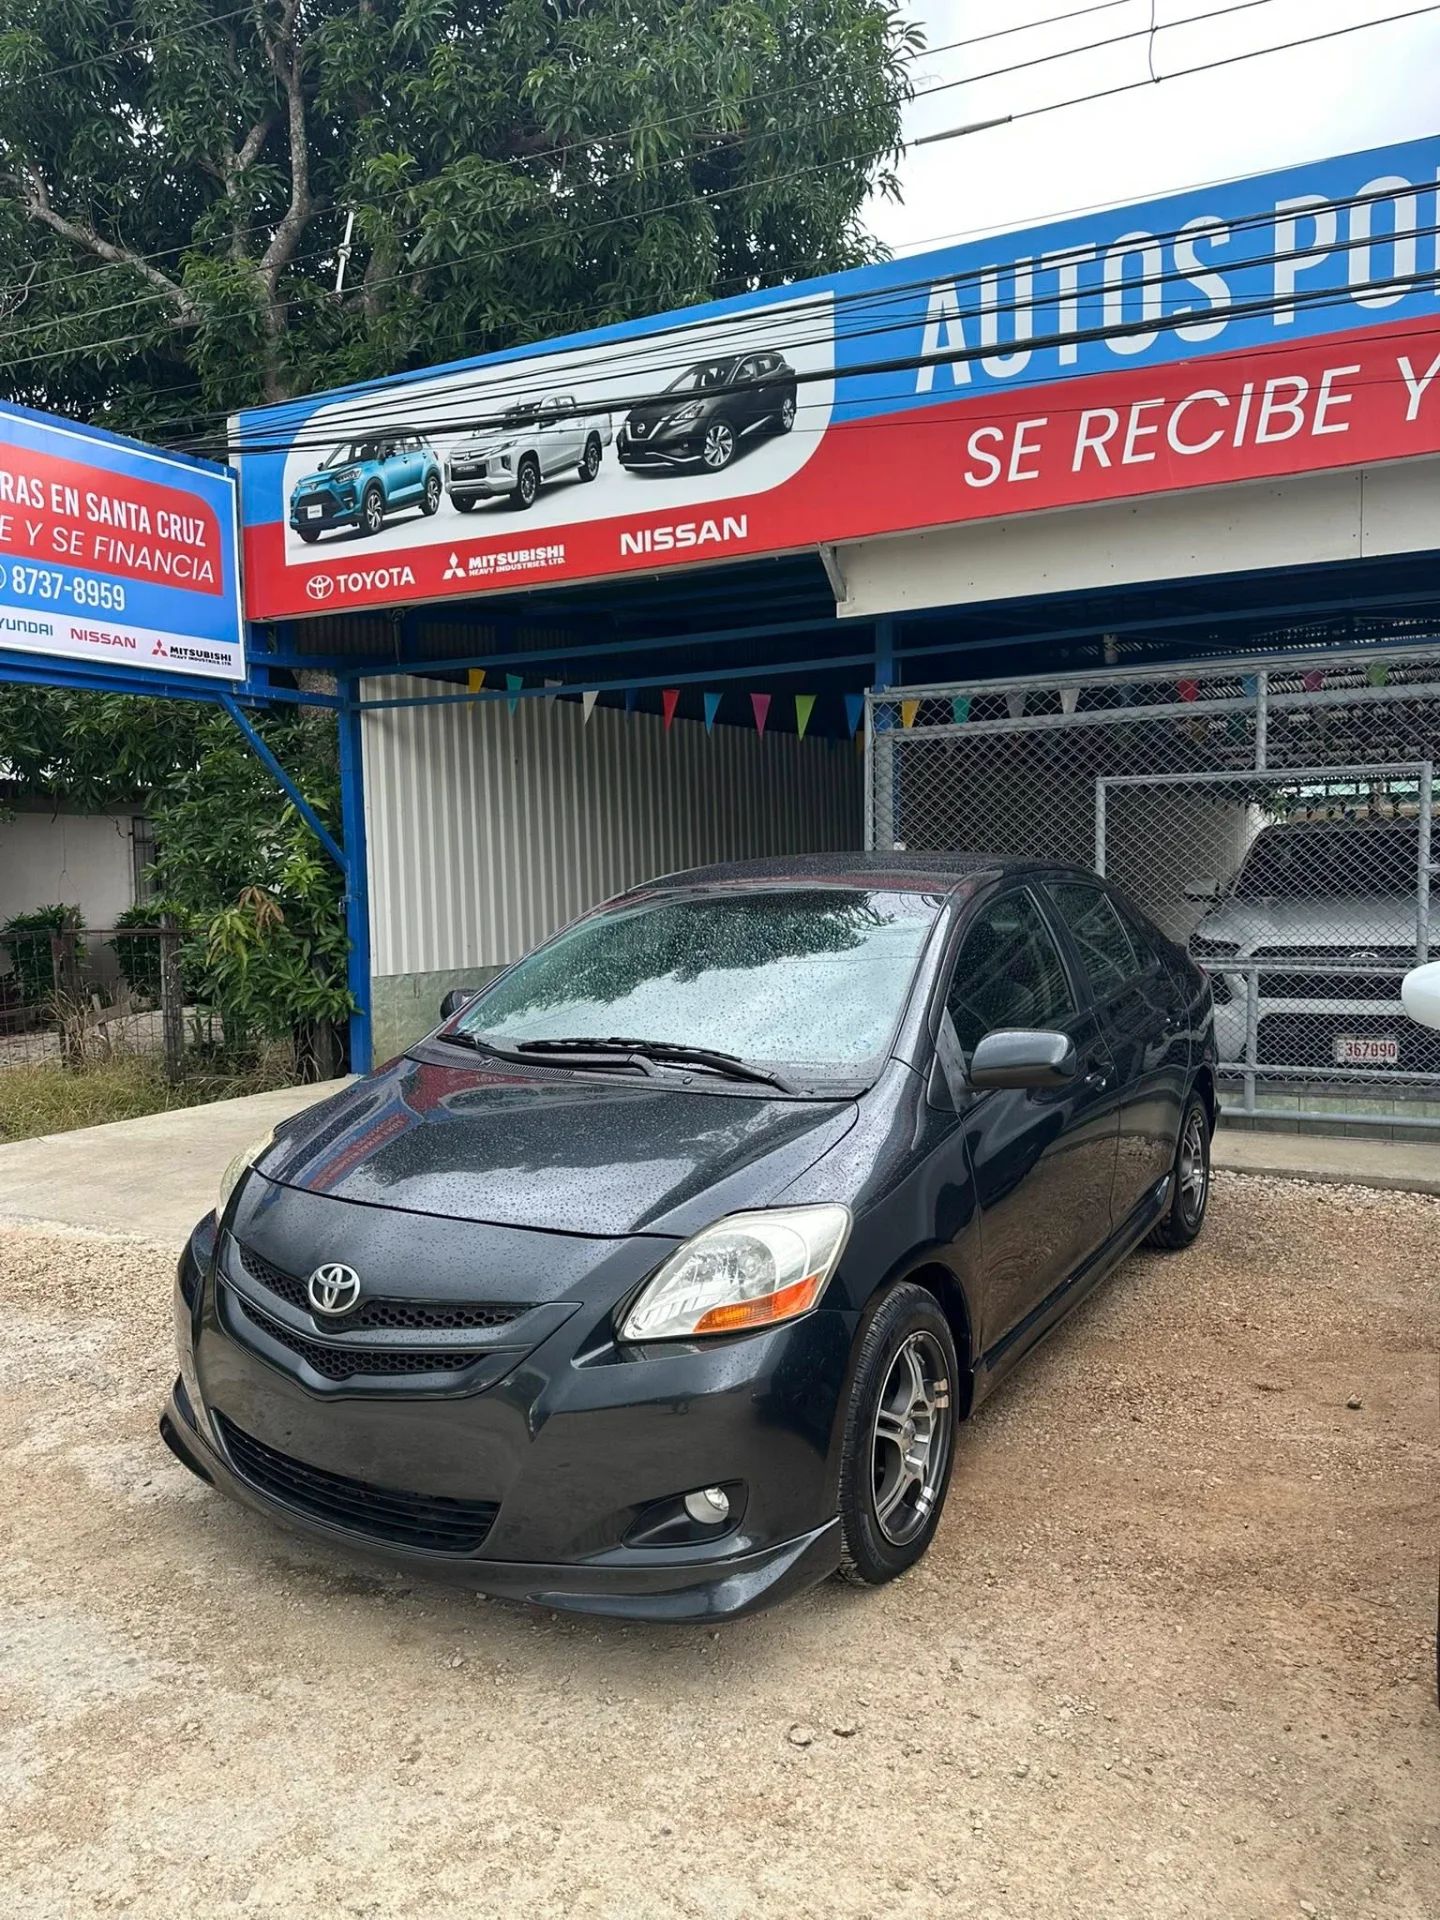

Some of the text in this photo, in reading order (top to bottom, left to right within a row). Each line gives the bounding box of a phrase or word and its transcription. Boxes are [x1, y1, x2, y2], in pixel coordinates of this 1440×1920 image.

[915, 166, 1440, 393] AUTOS PO
[964, 353, 1440, 488] SE RECIBE Y
[0, 470, 206, 547] RAS EN SANTA CRUZ
[25, 520, 43, 546] Y
[52, 526, 85, 556] SE
[94, 535, 214, 583] FINANCIA
[620, 514, 748, 556] NISSAN
[468, 544, 564, 570] MITSUBISHI
[468, 566, 495, 577] HEAVY
[549, 557, 566, 566] LTD.
[12, 565, 125, 611] 8737-8959
[336, 565, 415, 594] TOYOTA
[70, 628, 136, 648] NISSAN
[170, 646, 231, 661] MITSUBISHI
